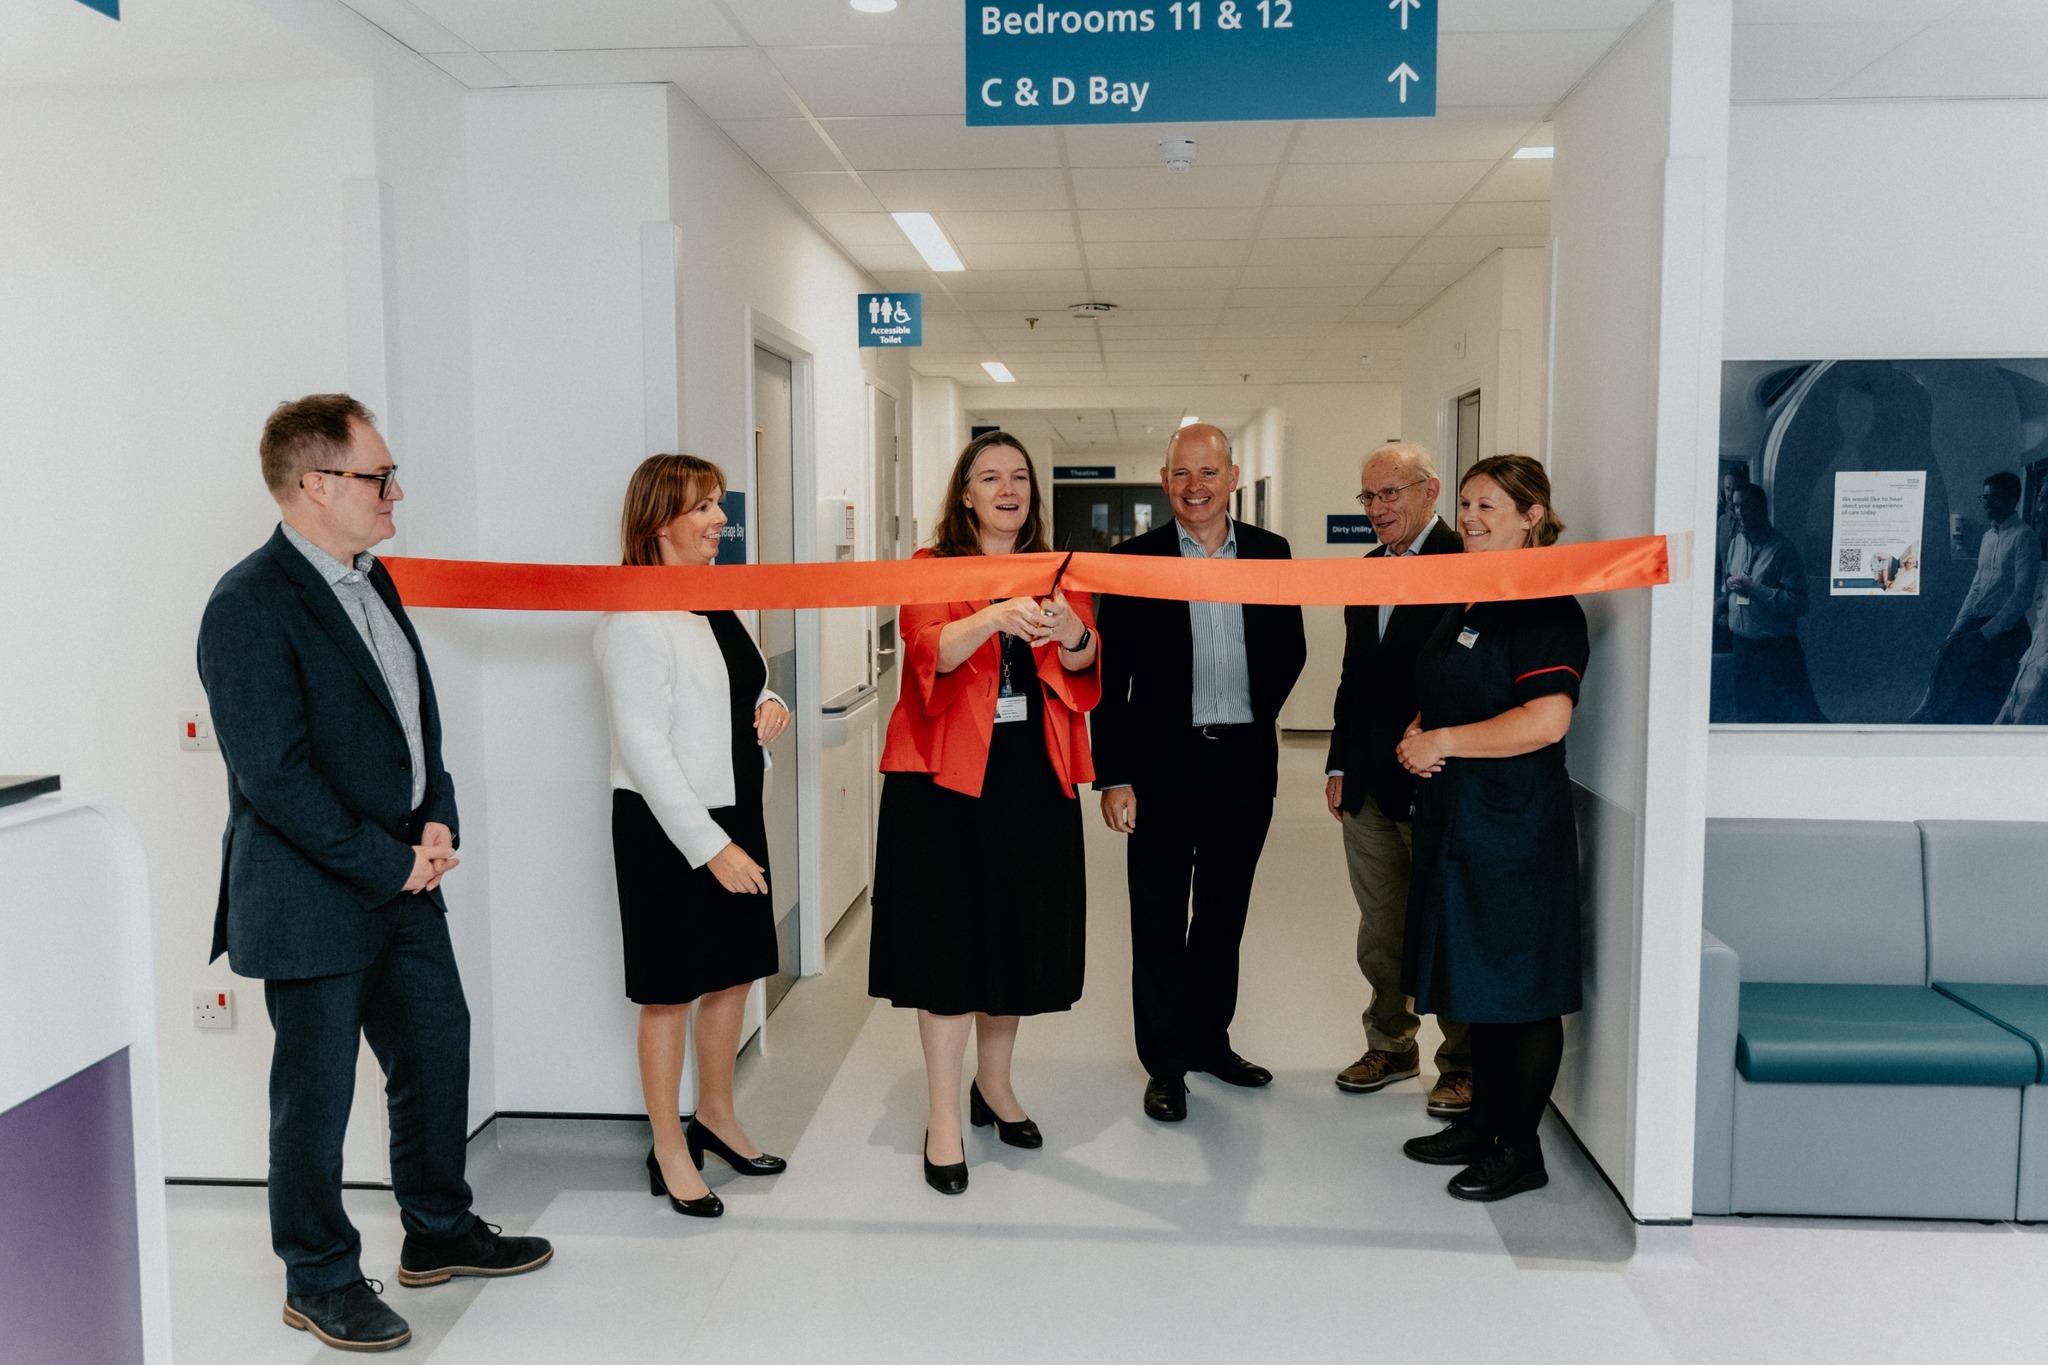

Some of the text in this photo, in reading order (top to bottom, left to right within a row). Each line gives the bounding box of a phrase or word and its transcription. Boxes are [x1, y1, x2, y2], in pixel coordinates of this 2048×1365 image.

[981, 0, 1294, 35] Bedrooms 11 & 12
[981, 76, 1150, 112] C & D Bay
[870, 326, 911, 335] Accessible
[880, 336, 902, 344] Toilet
[1070, 469, 1099, 477] Theatres
[719, 523, 745, 541] verage Bay
[1332, 526, 1373, 534] Dirty Utility
